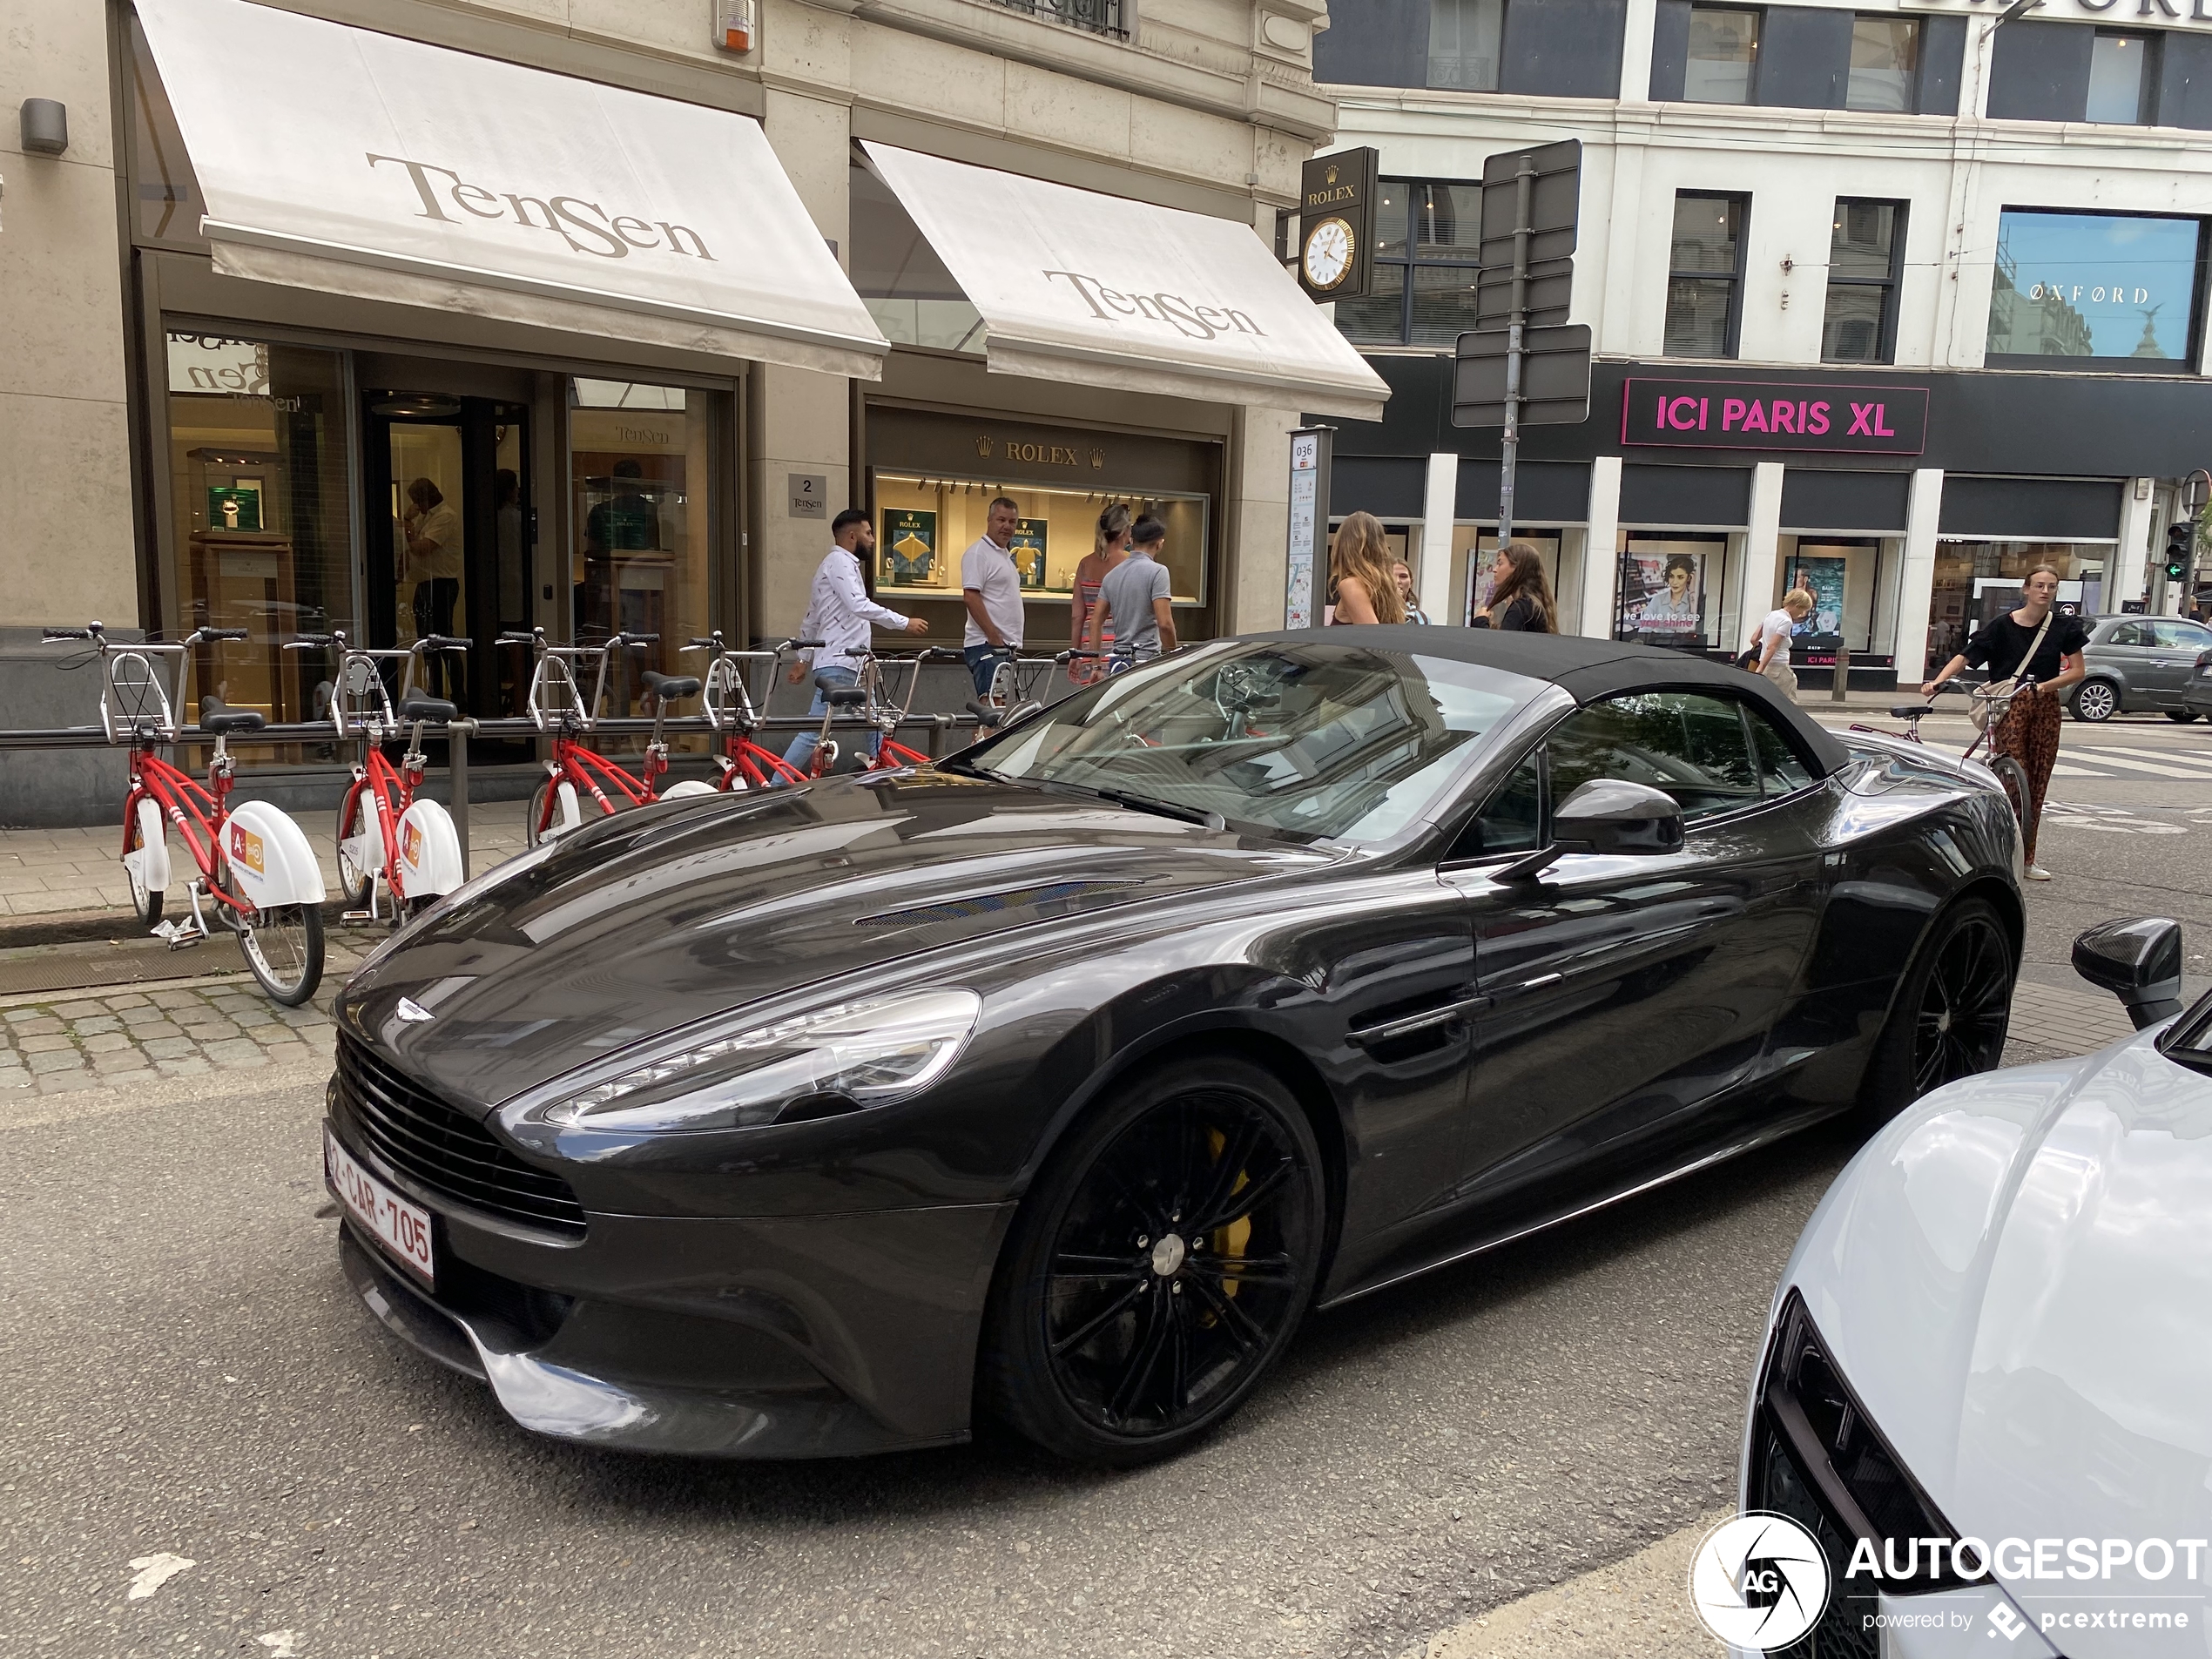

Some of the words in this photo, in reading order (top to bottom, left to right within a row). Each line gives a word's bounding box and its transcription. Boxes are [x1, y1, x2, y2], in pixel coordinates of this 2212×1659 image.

[1308, 185, 1355, 206] ROLEX
[365, 152, 719, 261] TenSen
[1042, 270, 1269, 341] TenSen
[1656, 396, 1709, 431] ICI
[1722, 398, 1831, 435] PARIS
[1846, 402, 1895, 437] XL
[615, 426, 669, 445] TenSen
[1006, 442, 1078, 467] ROLEX
[1296, 444, 1312, 457] 036
[803, 480, 812, 492] 2
[793, 498, 822, 509] TenSen
[1641, 619, 1660, 628] you
[1663, 619, 1694, 628] shine
[1667, 612, 1678, 621] to
[1681, 613, 1701, 622] see
